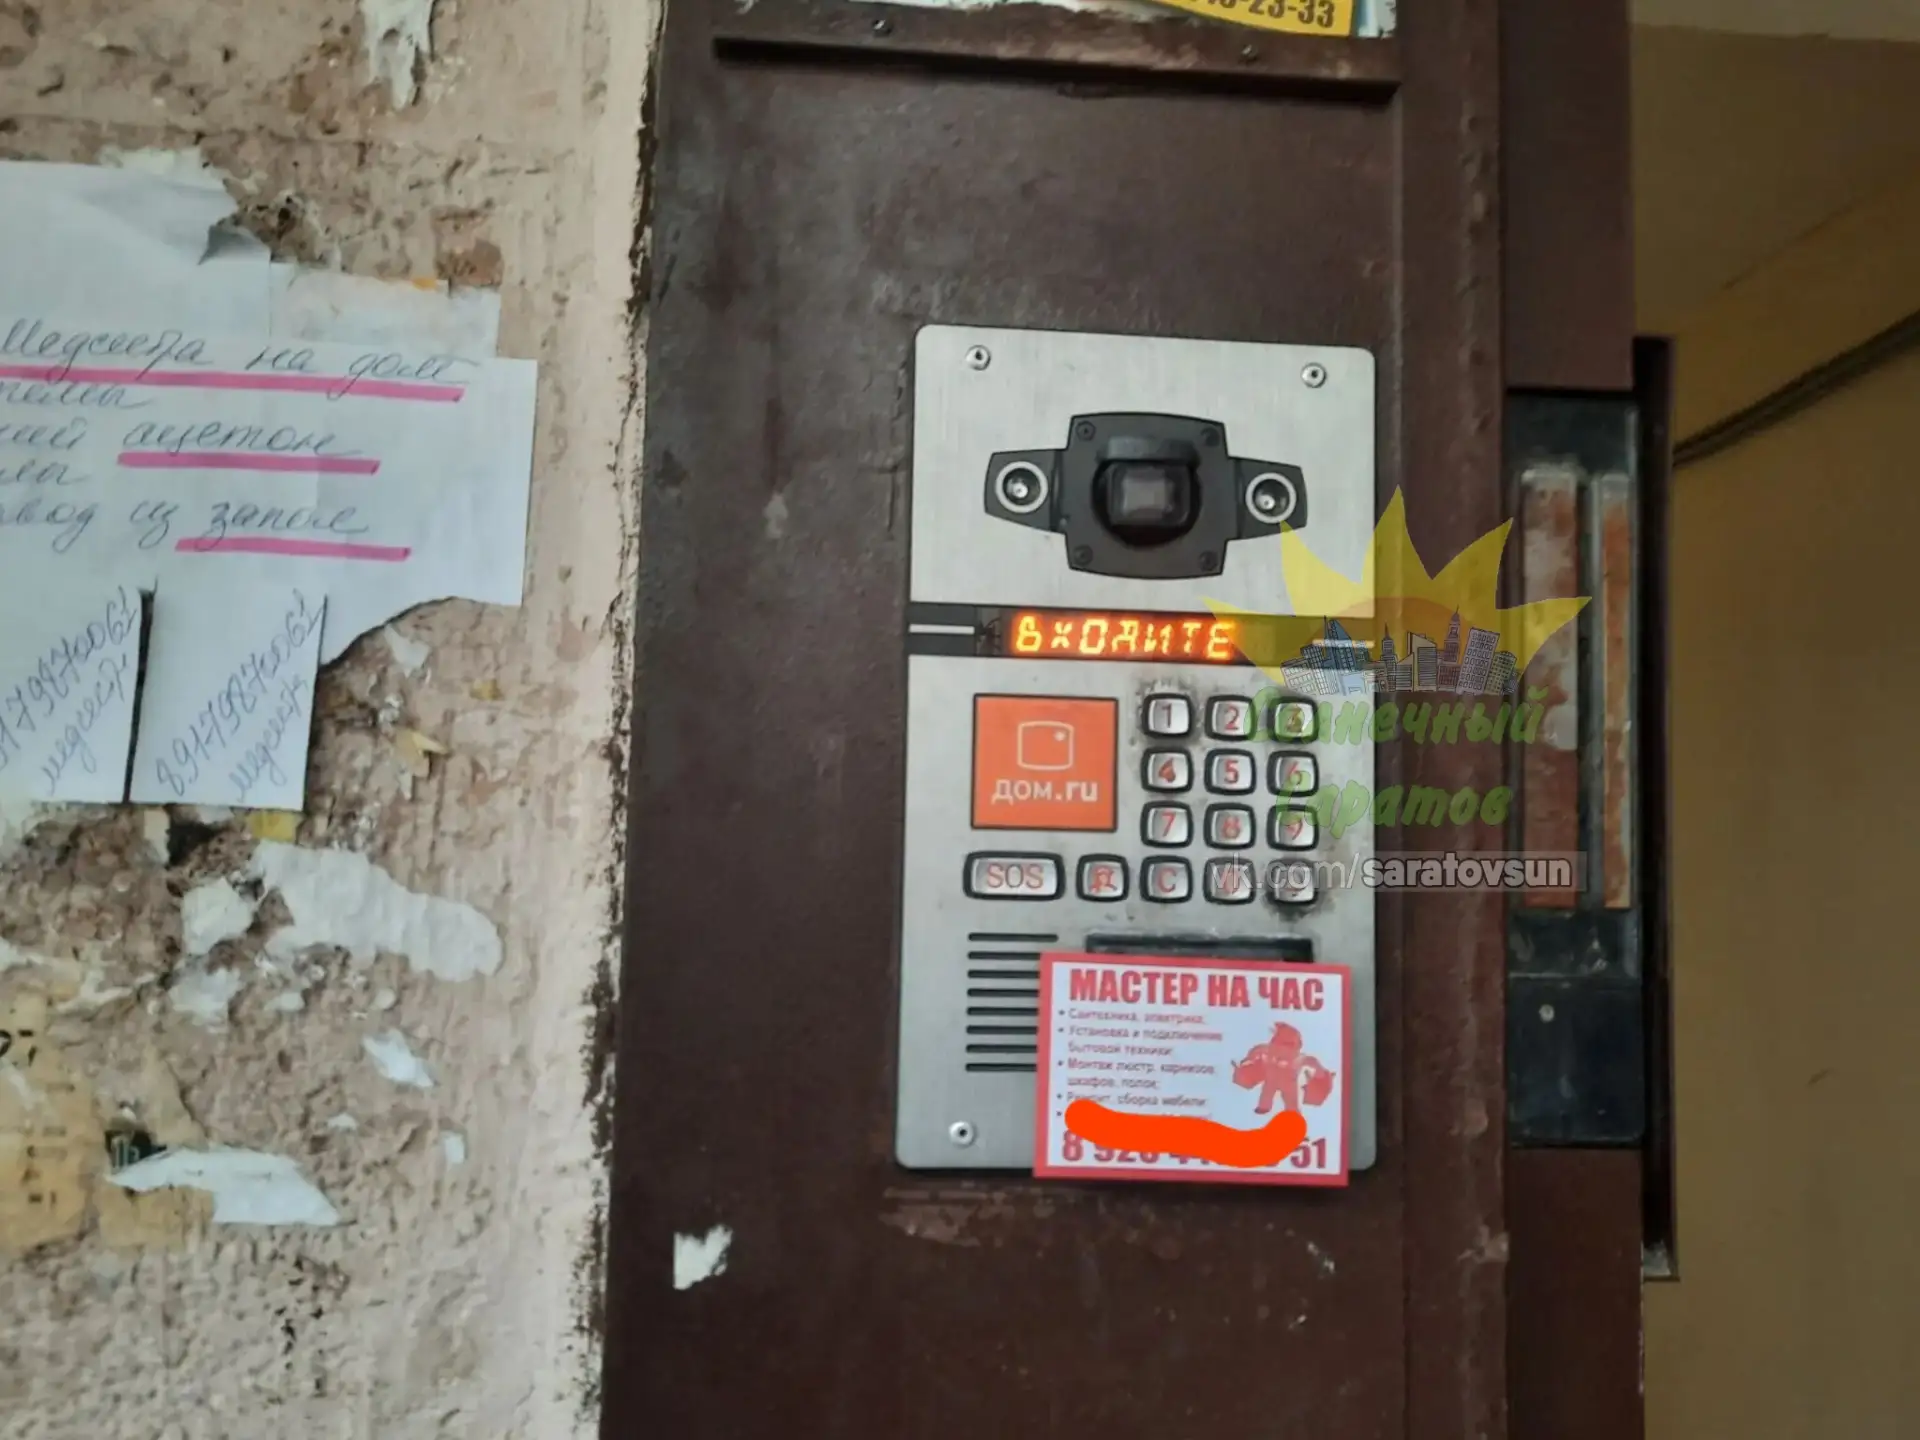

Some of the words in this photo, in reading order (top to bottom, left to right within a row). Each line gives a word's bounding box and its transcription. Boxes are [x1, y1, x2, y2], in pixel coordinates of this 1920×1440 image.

[245, 347, 316, 373] на
[1160, 703, 1173, 729] 1
[1224, 705, 1239, 731] 2
[1157, 757, 1177, 783] 4
[1223, 759, 1240, 784] 5
[1286, 761, 1303, 786] 6
[1161, 811, 1177, 838] 7
[1222, 815, 1241, 840] 8
[1285, 815, 1304, 841] 9
[985, 862, 1045, 890] SOS
[1070, 968, 1198, 1005] МАСТЕР
[1207, 974, 1251, 1008] НА
[1258, 976, 1324, 1011] ЧАС
